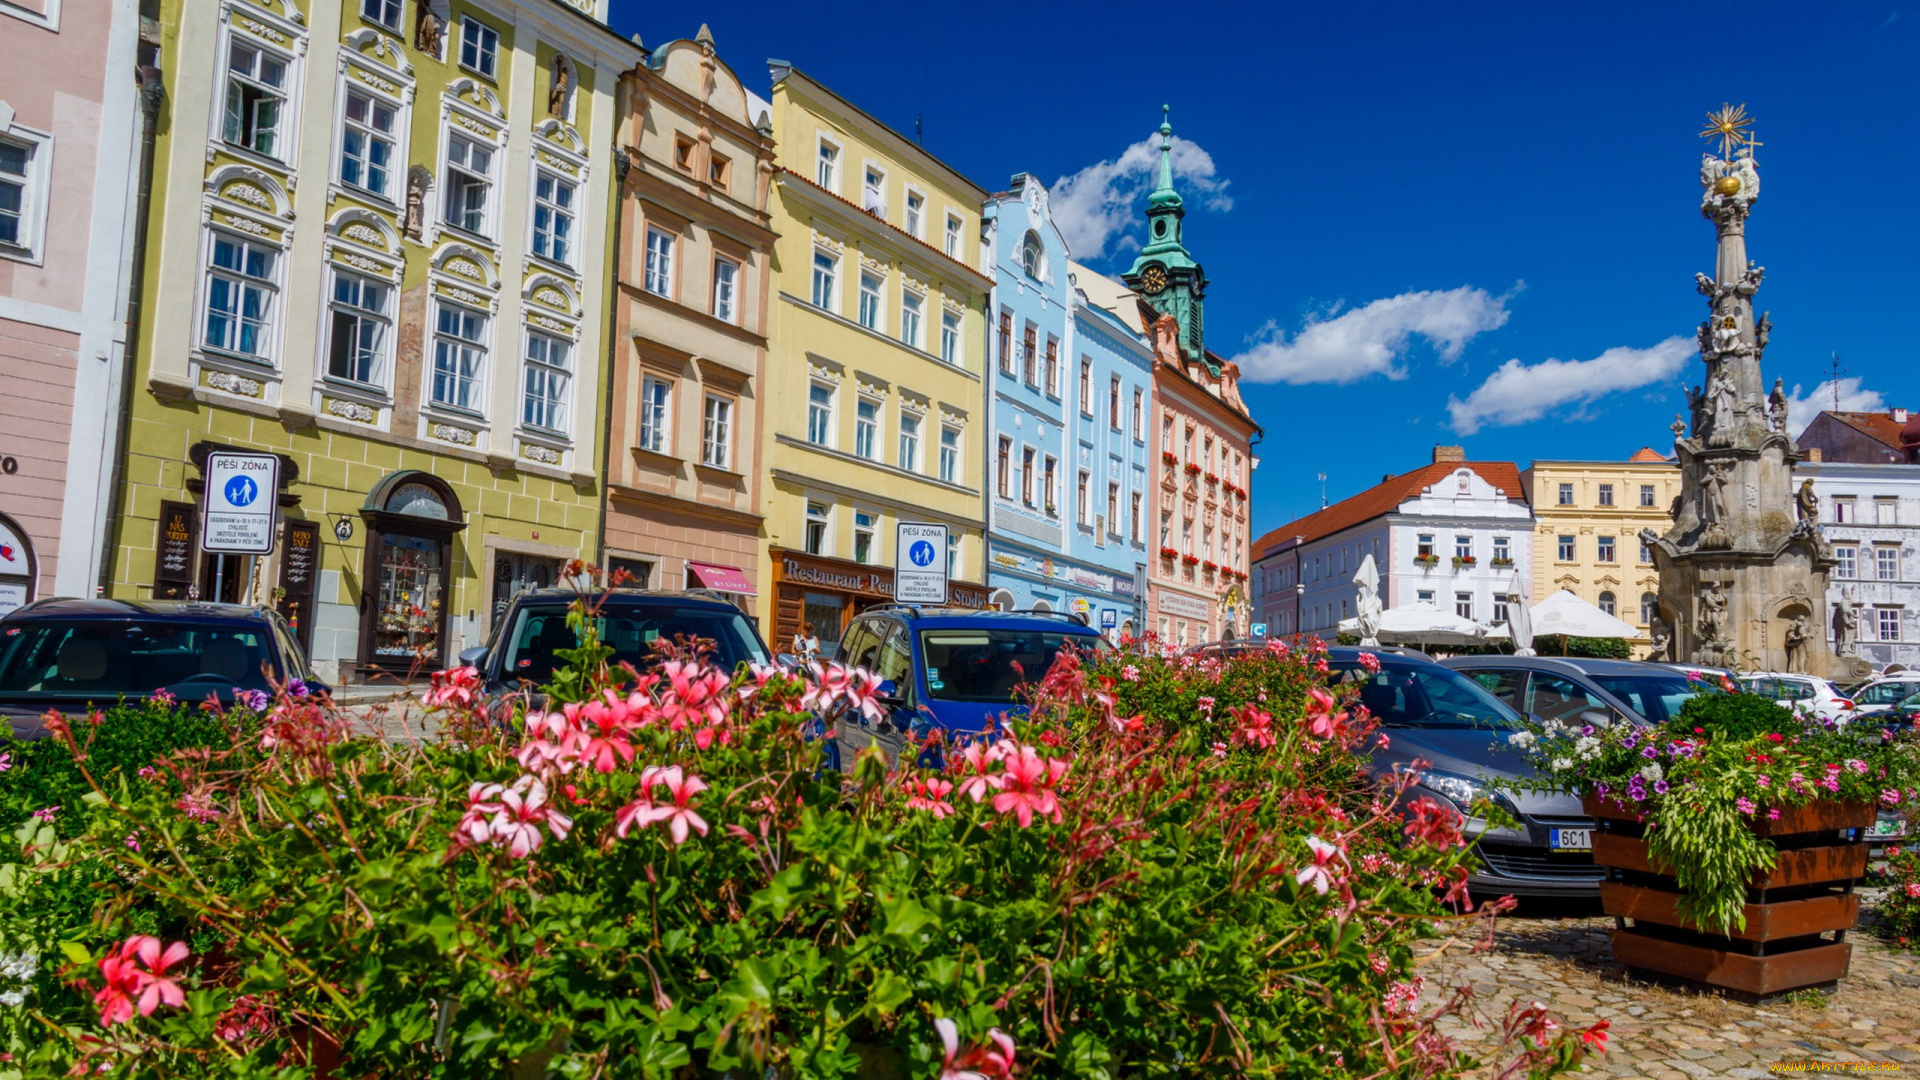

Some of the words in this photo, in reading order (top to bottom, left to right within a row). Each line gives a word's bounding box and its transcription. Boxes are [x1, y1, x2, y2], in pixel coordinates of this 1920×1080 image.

[217, 458, 238, 470] PĚŠÍ
[241, 460, 268, 471] ZÓNA
[903, 527, 920, 536] PĚŠÍ
[921, 528, 942, 537] ZÓNA
[785, 559, 862, 590] Restaurant
[869, 573, 894, 595] Pen
[954, 588, 987, 610] Studio
[1561, 830, 1585, 846] 6C1
